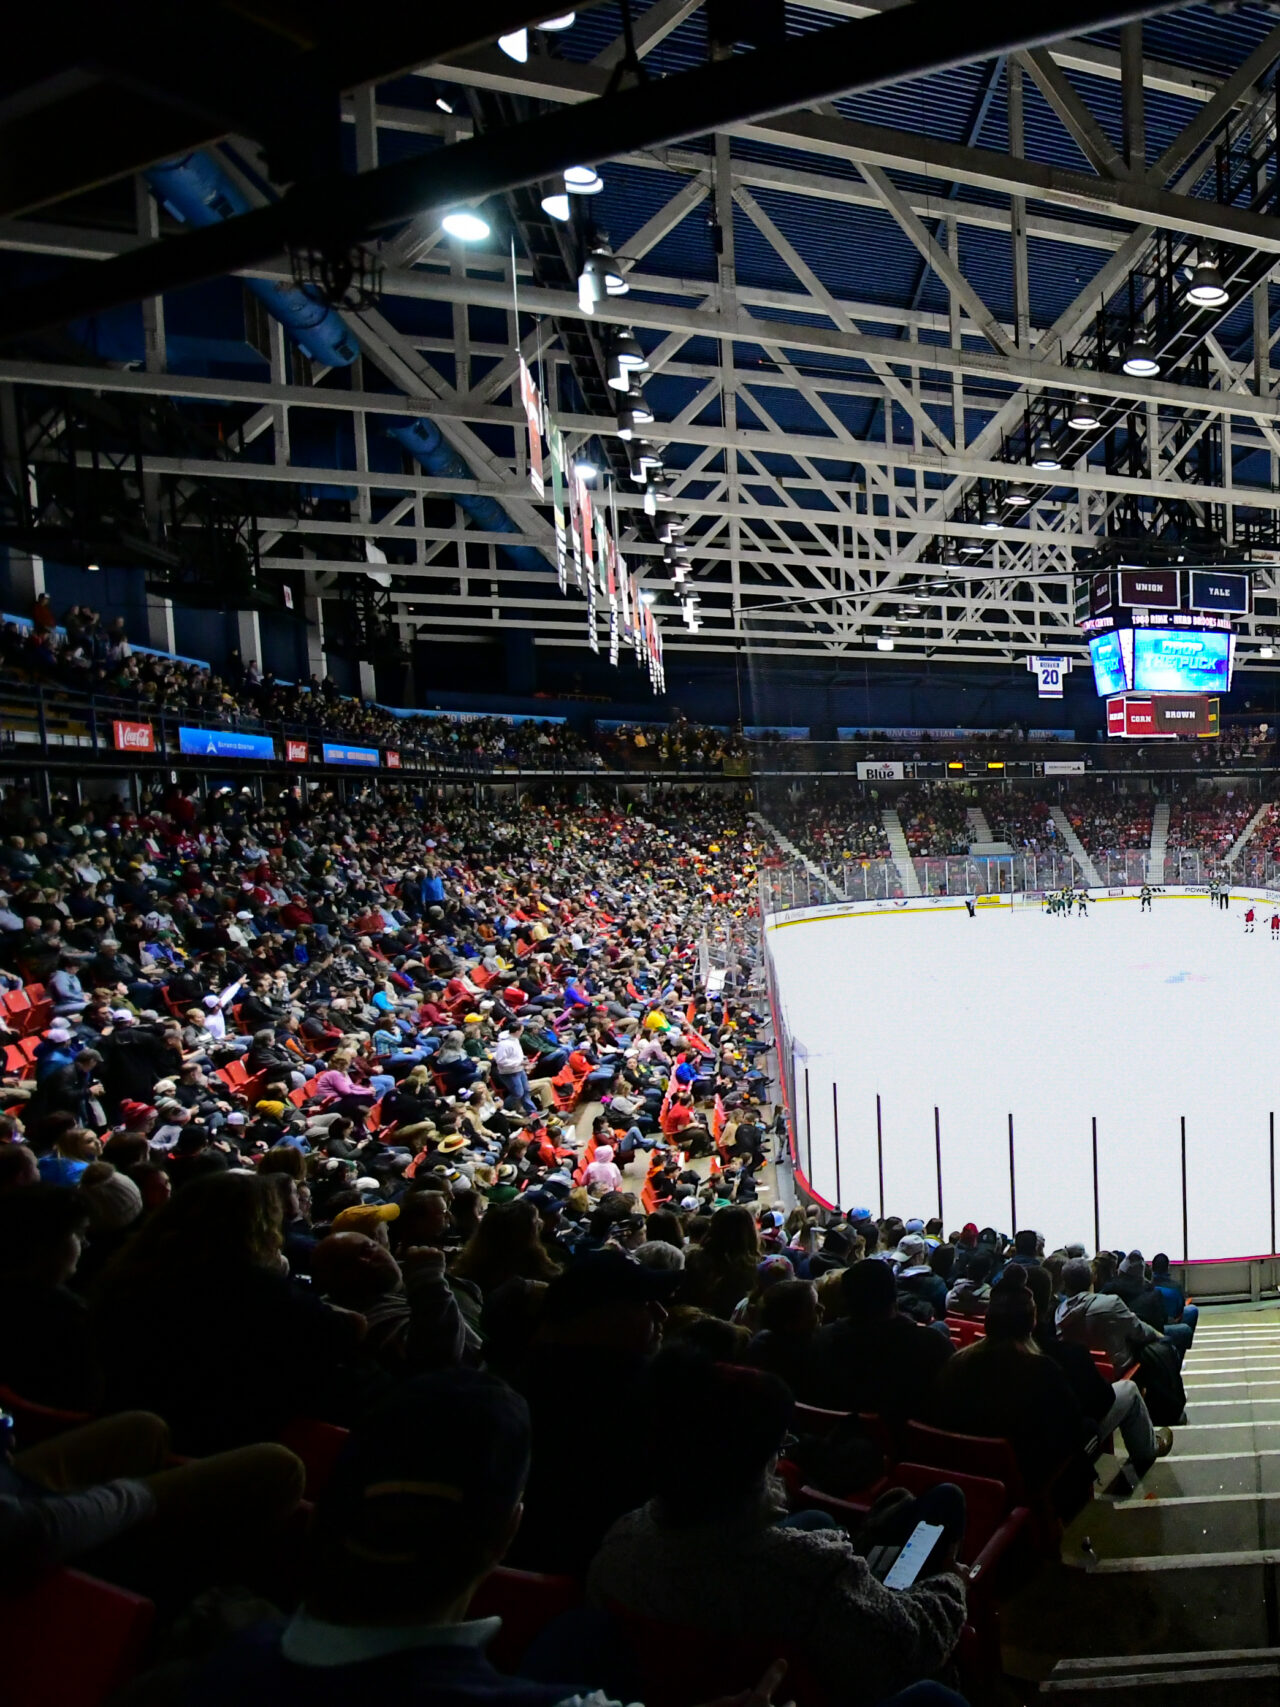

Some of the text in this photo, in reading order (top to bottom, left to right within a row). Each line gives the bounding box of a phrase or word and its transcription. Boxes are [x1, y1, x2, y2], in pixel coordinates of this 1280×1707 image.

[1136, 582, 1164, 592] UNION
[1209, 588, 1230, 596] YALE
[1179, 656, 1217, 670] PUCK
[1042, 669, 1059, 685] 20
[1166, 711, 1196, 719] BROWN
[124, 728, 150, 747] Coca-Cola
[170, 770, 177, 784] 8
[866, 769, 894, 780] Blue
